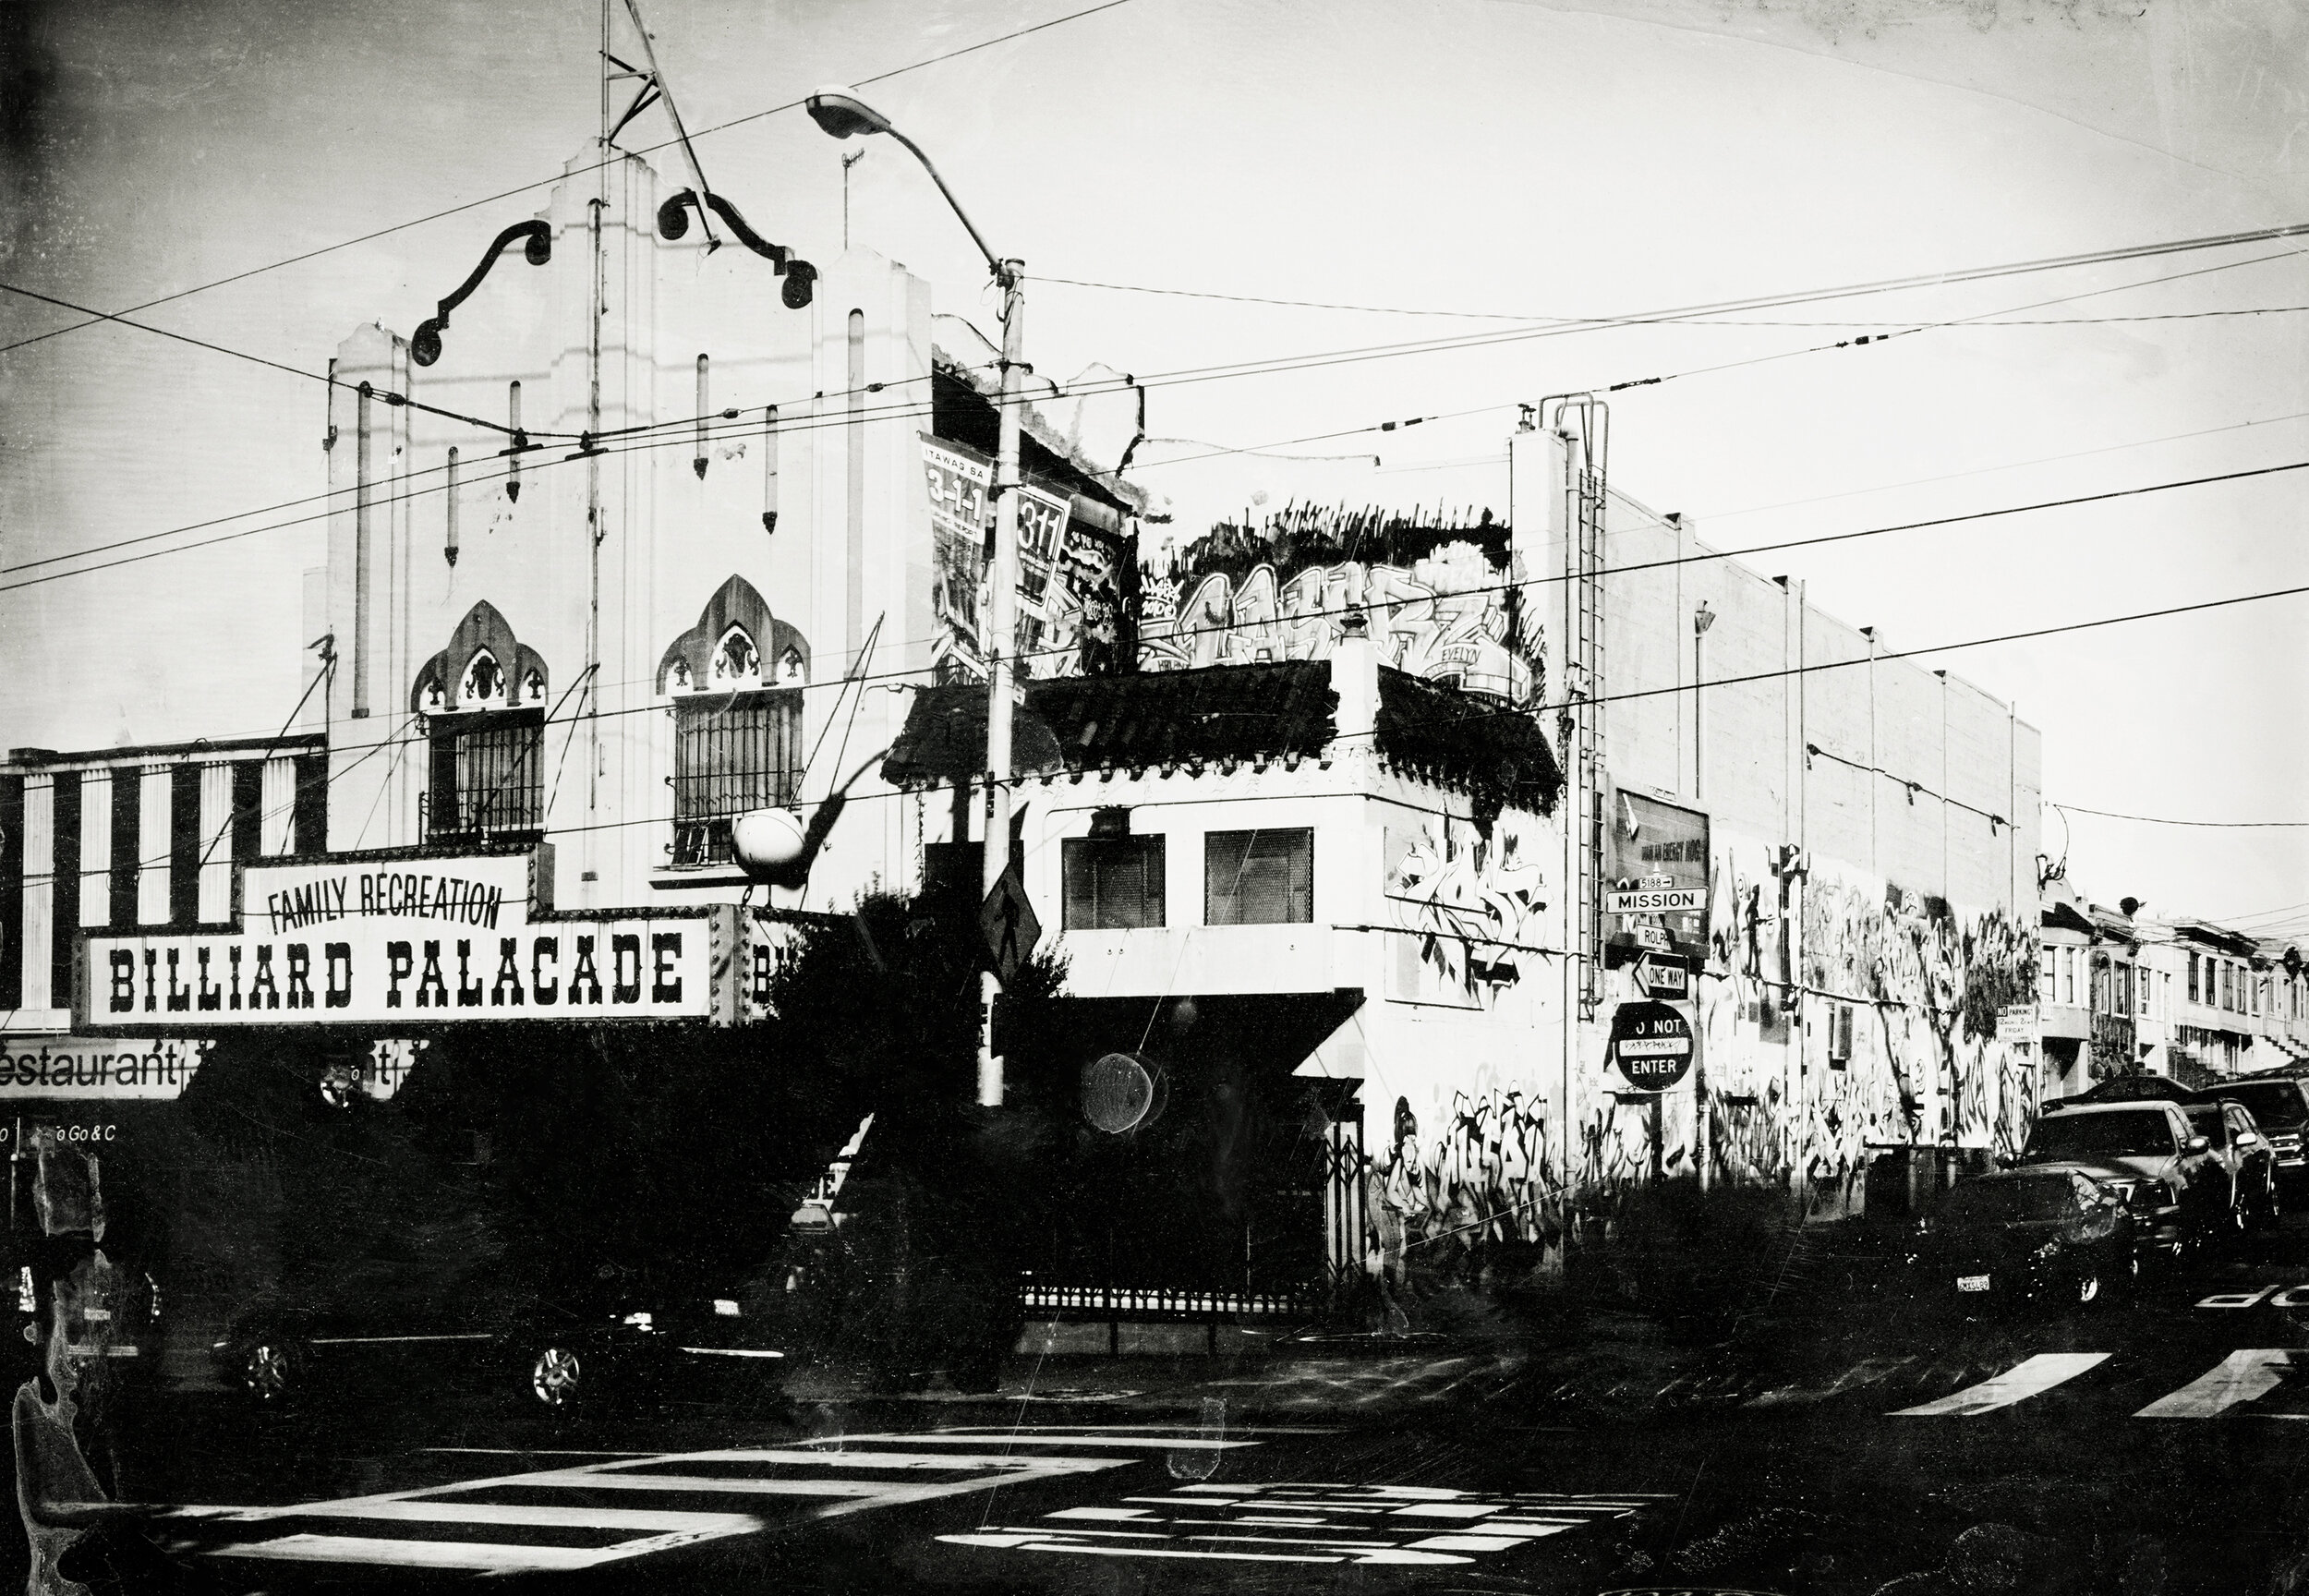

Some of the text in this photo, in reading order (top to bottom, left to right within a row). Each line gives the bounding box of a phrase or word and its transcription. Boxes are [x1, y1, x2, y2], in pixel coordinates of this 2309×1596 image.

[970, 467, 984, 479] SA
[927, 468, 983, 522] 3-1-1
[1017, 502, 1060, 560] 311
[1442, 647, 1481, 663] EVELYN
[1641, 878, 1662, 888] 5188
[268, 873, 502, 936] FAMILY RECREATION
[1618, 893, 1694, 908] MISSION
[109, 932, 683, 1013] BILLIARD PALACADE
[1650, 967, 1683, 986] ONE WAY
[1998, 1007, 2007, 1016] NO
[1654, 1020, 1681, 1034] NOT
[1632, 1059, 1676, 1074] ENTER
[68, 1125, 88, 1141] Go
